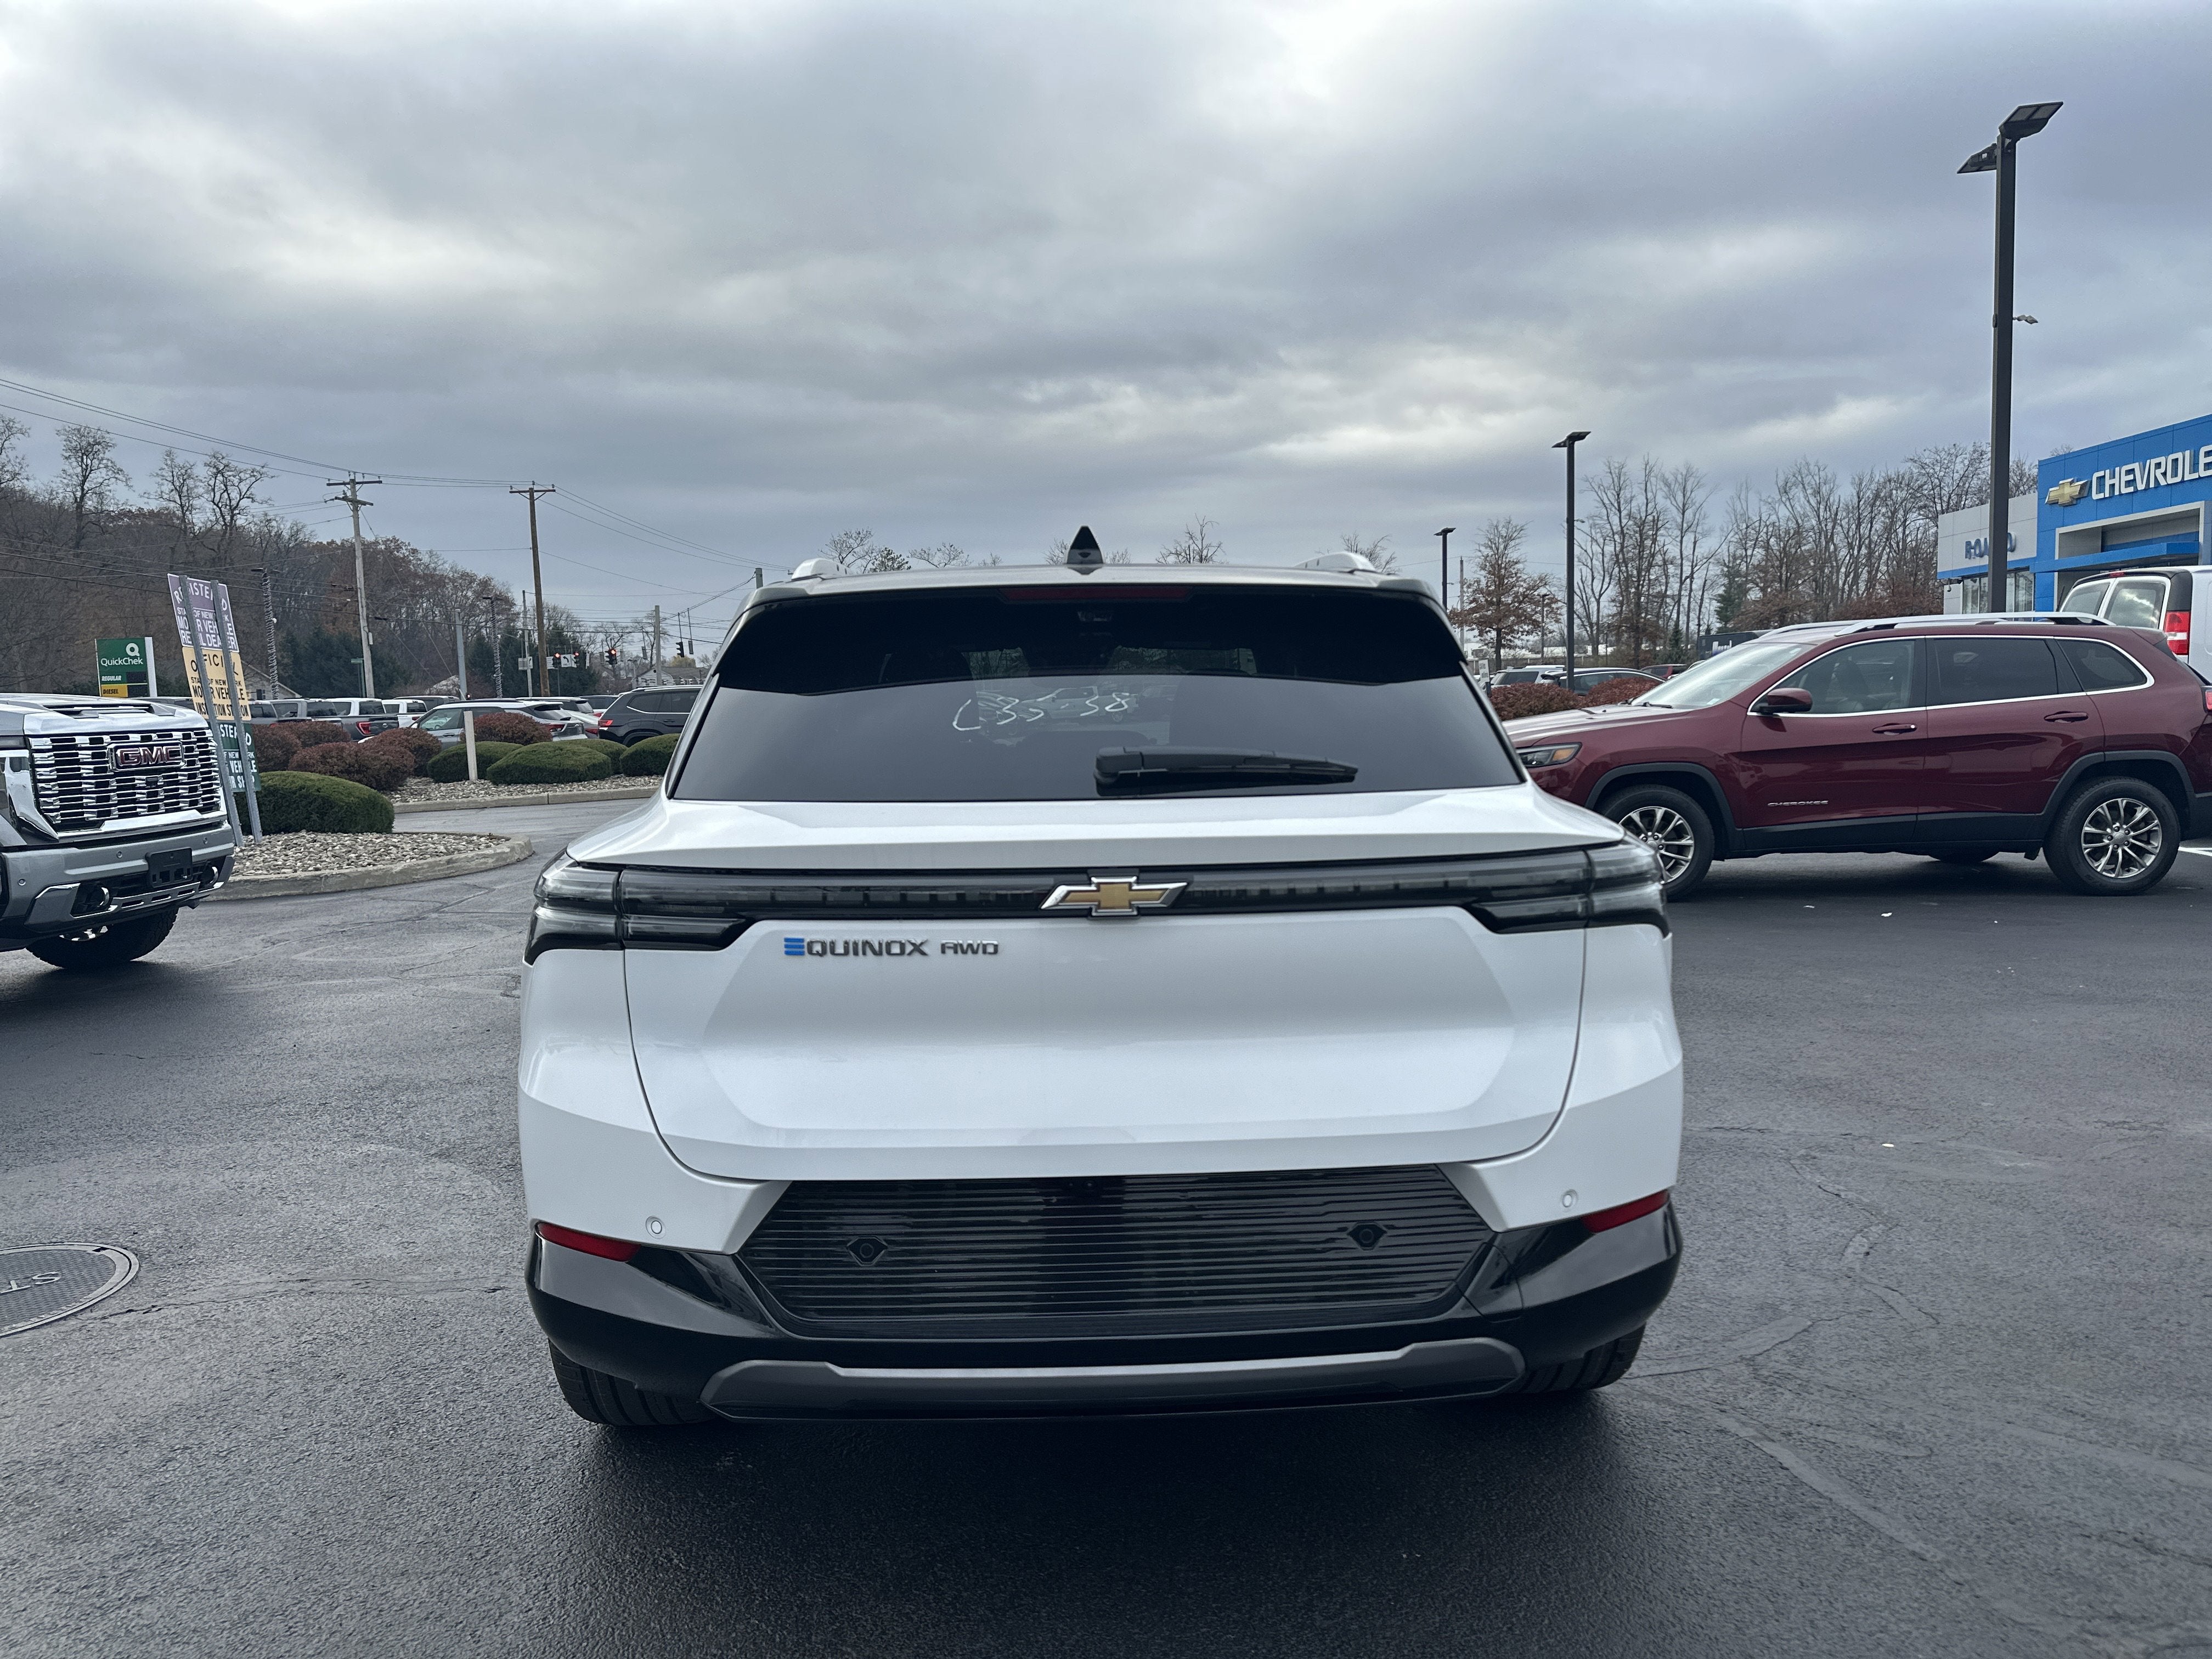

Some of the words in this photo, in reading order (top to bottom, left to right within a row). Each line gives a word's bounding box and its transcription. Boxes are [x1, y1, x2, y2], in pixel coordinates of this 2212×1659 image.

[2092, 444, 2212, 500] CHEVROLE
[100, 657, 143, 667] QuickChek
[116, 746, 183, 766] GMC
[784, 937, 929, 956] EQUINOX
[940, 940, 999, 955] AWD
